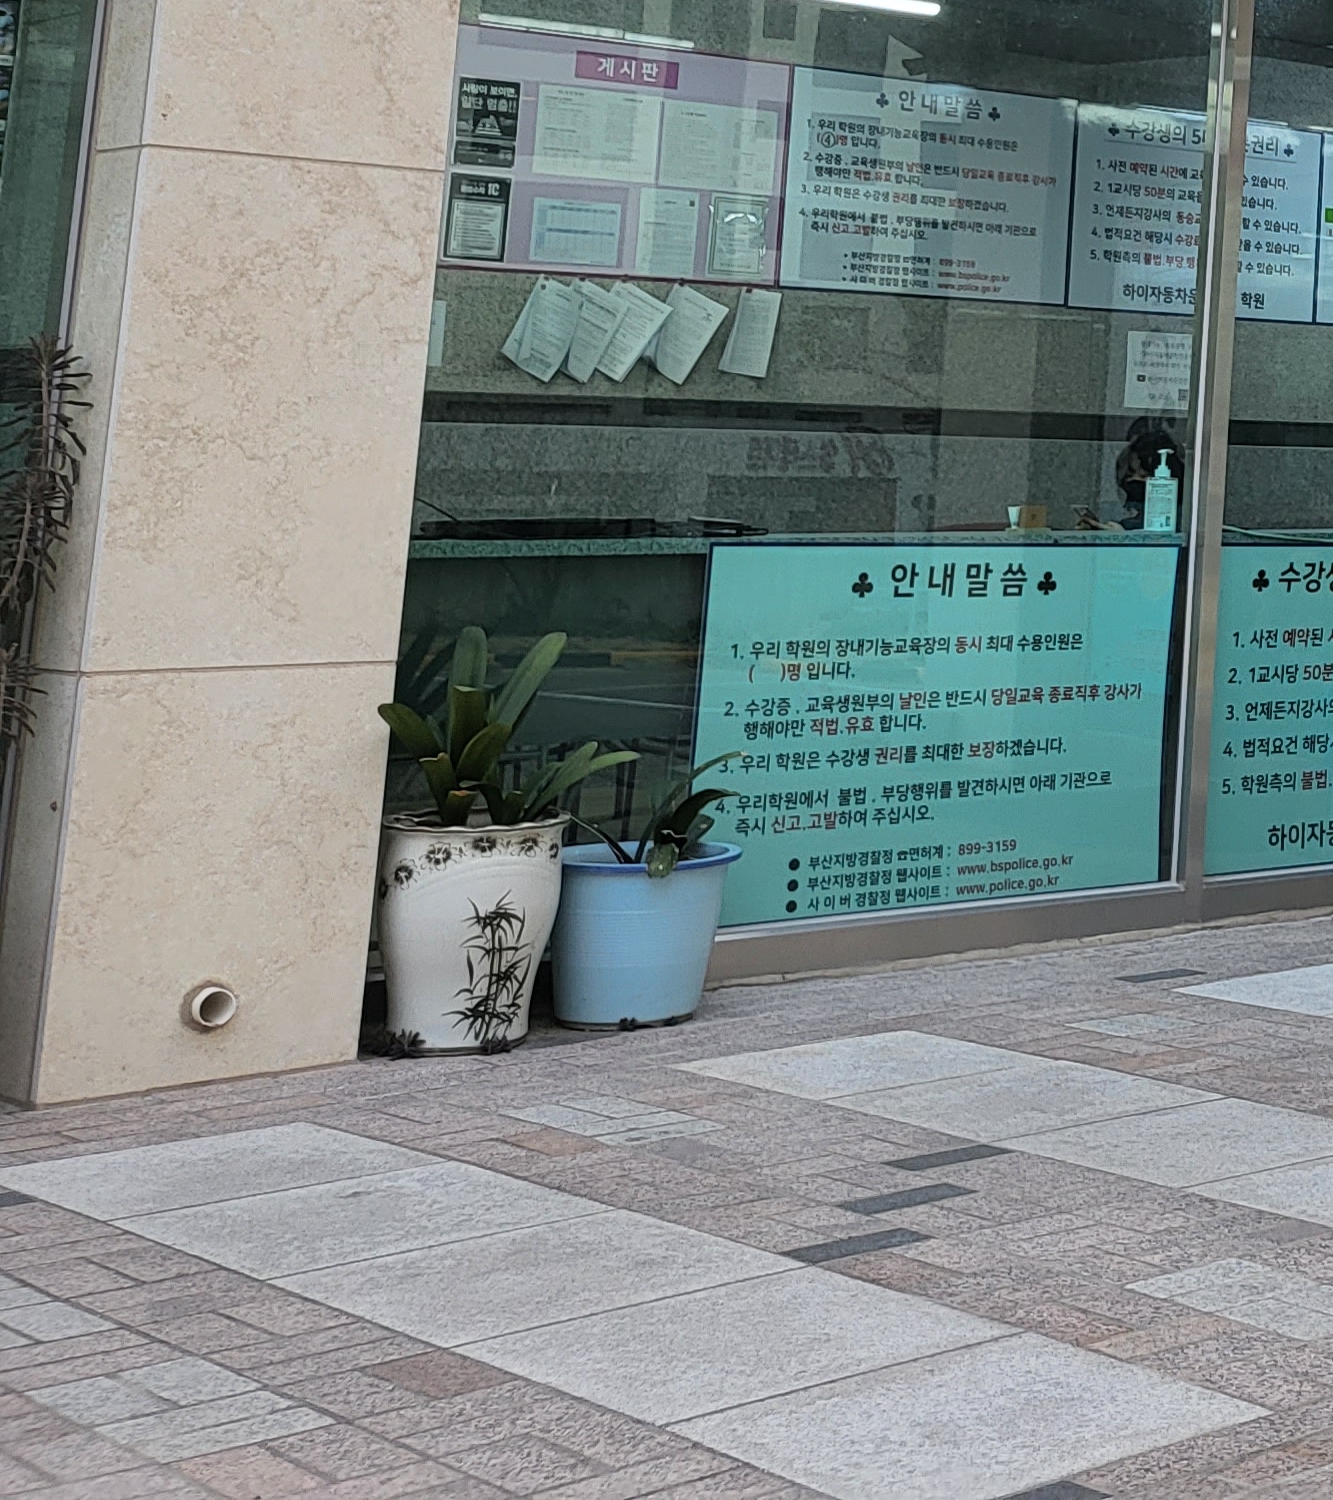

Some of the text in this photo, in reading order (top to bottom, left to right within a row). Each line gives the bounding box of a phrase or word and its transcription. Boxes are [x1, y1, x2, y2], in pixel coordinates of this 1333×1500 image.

[597, 55, 660, 83] 게시판
[898, 89, 982, 119] 안내말씀
[1123, 122, 1186, 146] 수강생의
[1107, 159, 1288, 190] 사전 있습니다.
[1240, 291, 1264, 309] 학원
[890, 562, 1027, 597] 안내말씀
[730, 633, 1083, 660] 1. 우리 학원의 장내기능교육장의 동시 최대 수용인원은
[1232, 631, 1244, 648] 1.
[1249, 628, 1278, 648] 사전
[1282, 627, 1323, 647] 예약된
[806, 660, 855, 680] 입니다.
[1227, 667, 1241, 684] 2.
[1248, 663, 1299, 683] 1교시당
[723, 682, 1141, 717] 2. 수강증 교육생원부의 날인은 반드시 당일교육 종료직후 강사가
[1225, 704, 1239, 721] 3.
[743, 718, 805, 740] 행해야만
[879, 713, 926, 732] 합니다.
[738, 753, 770, 773] 우리
[775, 750, 820, 771] 학원은
[825, 747, 869, 768] 수강생
[873, 745, 917, 764] 권리를
[921, 742, 964, 762] 최대한
[967, 736, 1066, 758] 보장하겠습니다.
[1222, 741, 1237, 757] 4.
[1242, 735, 1297, 758] 법적요건
[734, 788, 828, 814] 우리학원에서
[837, 786, 866, 806] 불법
[880, 780, 952, 803] 부당행위를
[957, 775, 1025, 797] 발견하시면
[1029, 773, 1056, 791] 아래
[1059, 770, 1112, 789] 기관으로
[1221, 778, 1235, 794] 5.
[1240, 771, 1296, 794] 학원측의
[734, 816, 765, 837] 즉시
[871, 804, 934, 826] 주십시오.
[958, 838, 1016, 855] 899-3159
[895, 864, 942, 882] 웹사이트
[956, 853, 1073, 875] www.bspolice.go.kr
[894, 884, 940, 903] 웹사이트
[955, 874, 1059, 895] www.police.go.kr
